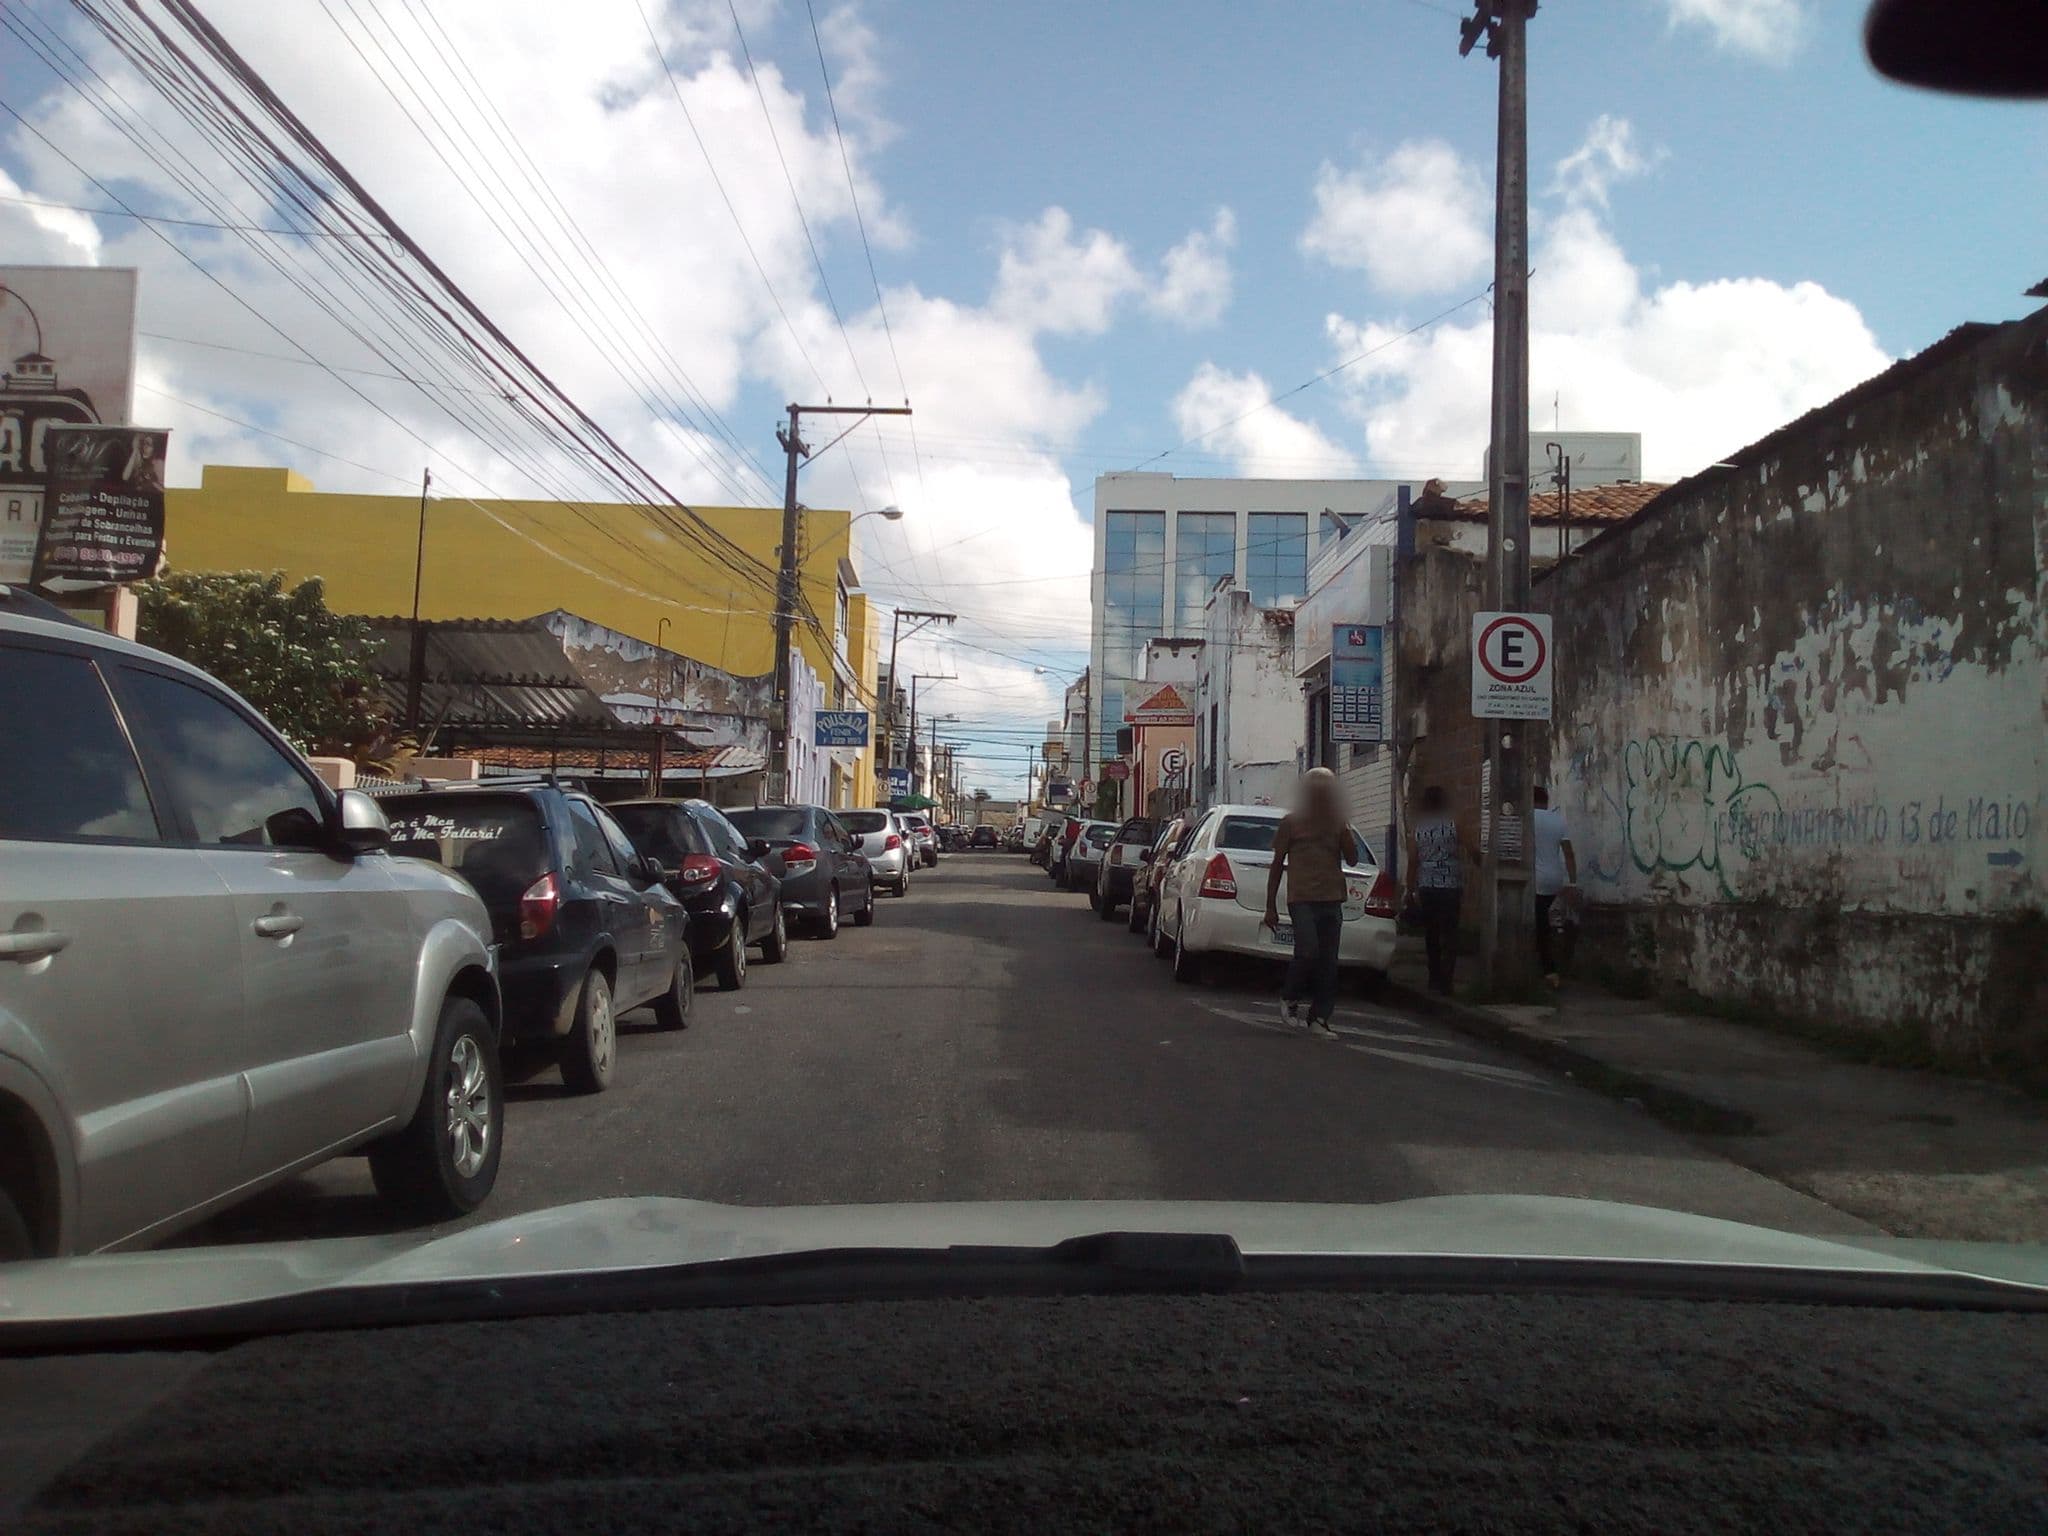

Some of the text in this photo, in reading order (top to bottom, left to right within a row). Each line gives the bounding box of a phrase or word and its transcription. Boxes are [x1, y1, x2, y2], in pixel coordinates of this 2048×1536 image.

[1501, 630, 1525, 668] E
[1488, 683, 1537, 694] ZONA AZUL
[816, 712, 868, 736] POUSADA
[1170, 755, 1181, 770] E
[424, 814, 455, 827] Meu
[1900, 801, 1921, 843] 13
[1929, 795, 1958, 842] de
[1967, 793, 2029, 840] Maio
[412, 827, 436, 840] Me
[440, 826, 503, 840] Faltará!
